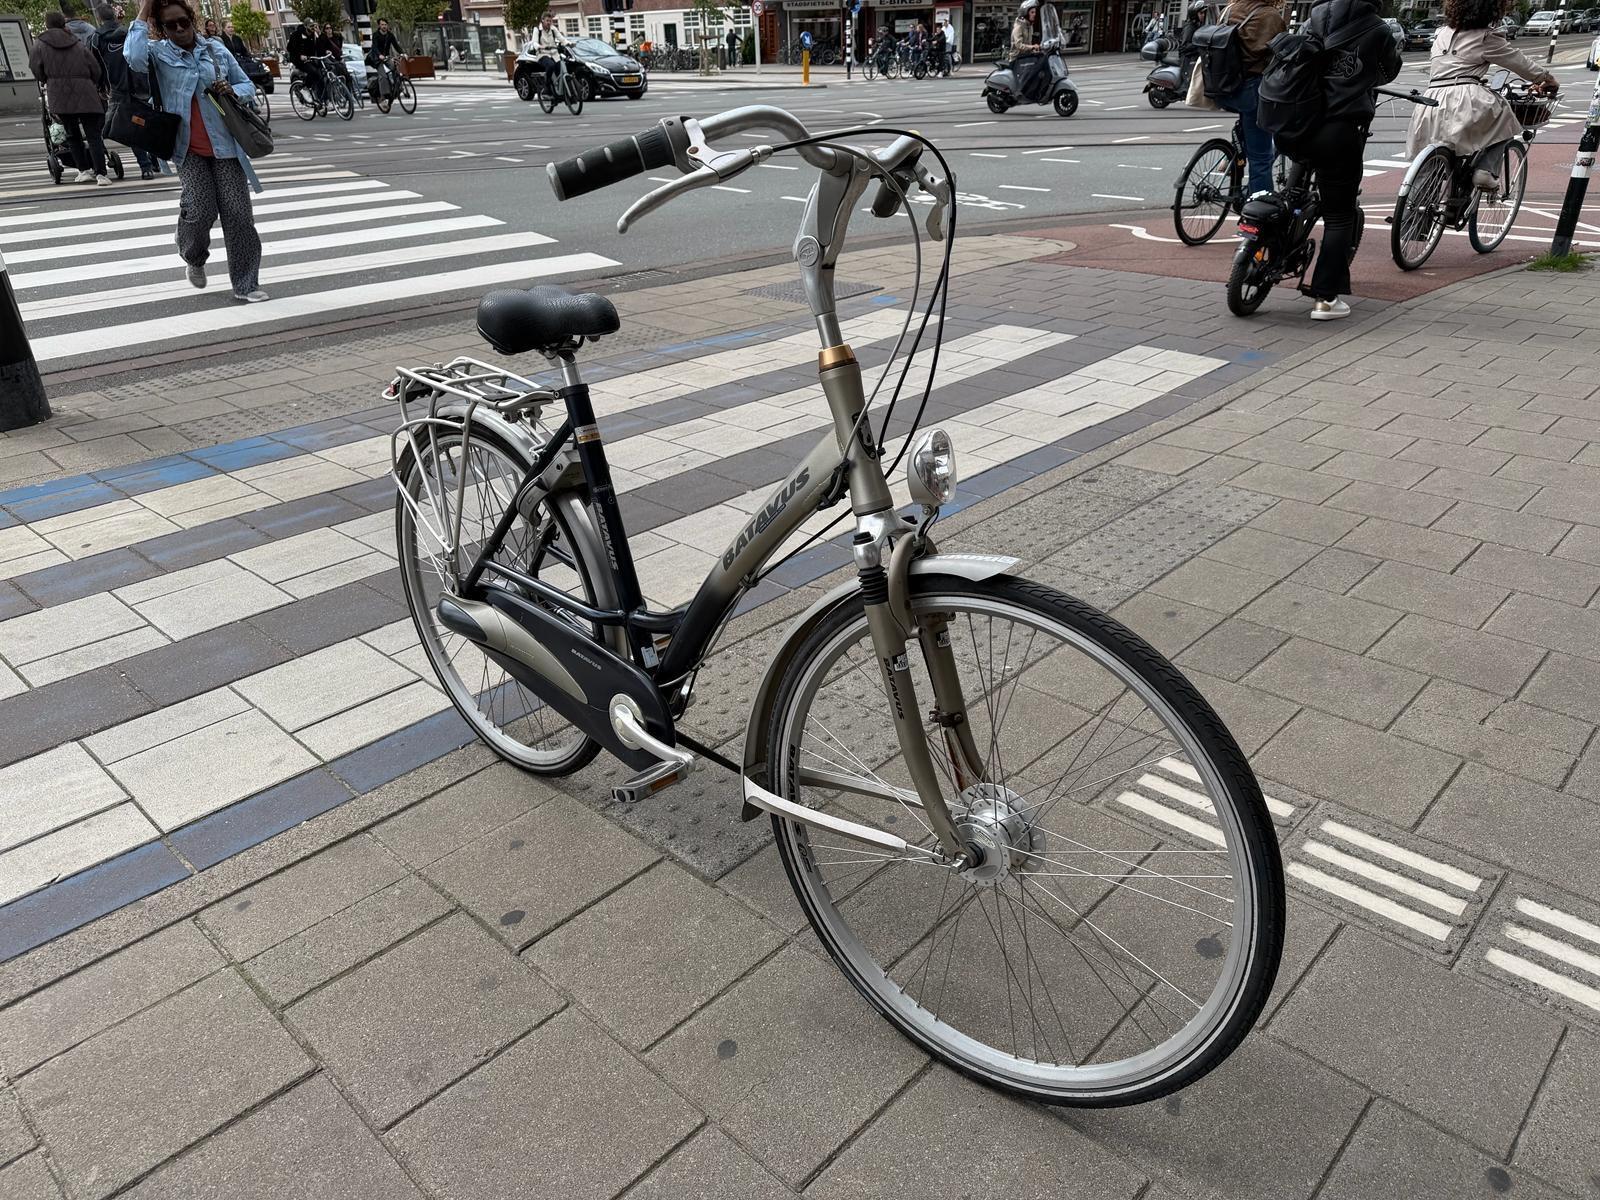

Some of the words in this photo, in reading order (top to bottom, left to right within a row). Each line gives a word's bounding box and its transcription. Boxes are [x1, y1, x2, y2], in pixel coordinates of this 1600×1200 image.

[595, 502, 619, 570] BATAVUS
[722, 466, 810, 572] BATAVUS
[571, 648, 602, 670] BATAVUS
[883, 657, 905, 720] BATAVUS
